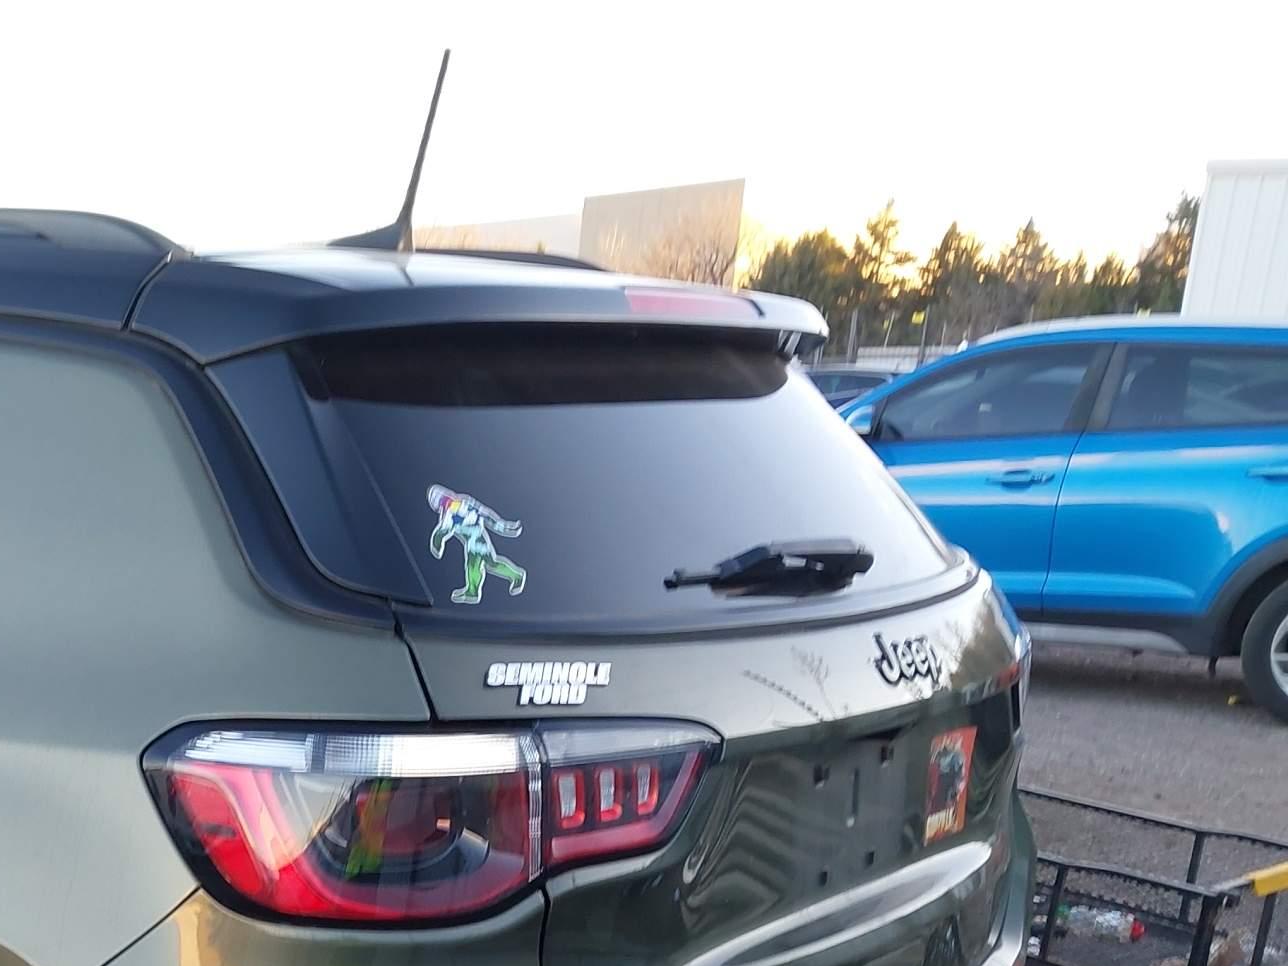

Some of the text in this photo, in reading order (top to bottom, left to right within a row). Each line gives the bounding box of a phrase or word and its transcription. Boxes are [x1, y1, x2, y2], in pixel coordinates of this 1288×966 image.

[872, 632, 942, 688] Jeep
[485, 661, 612, 687] SEMINOLE
[519, 682, 588, 706] FORD
